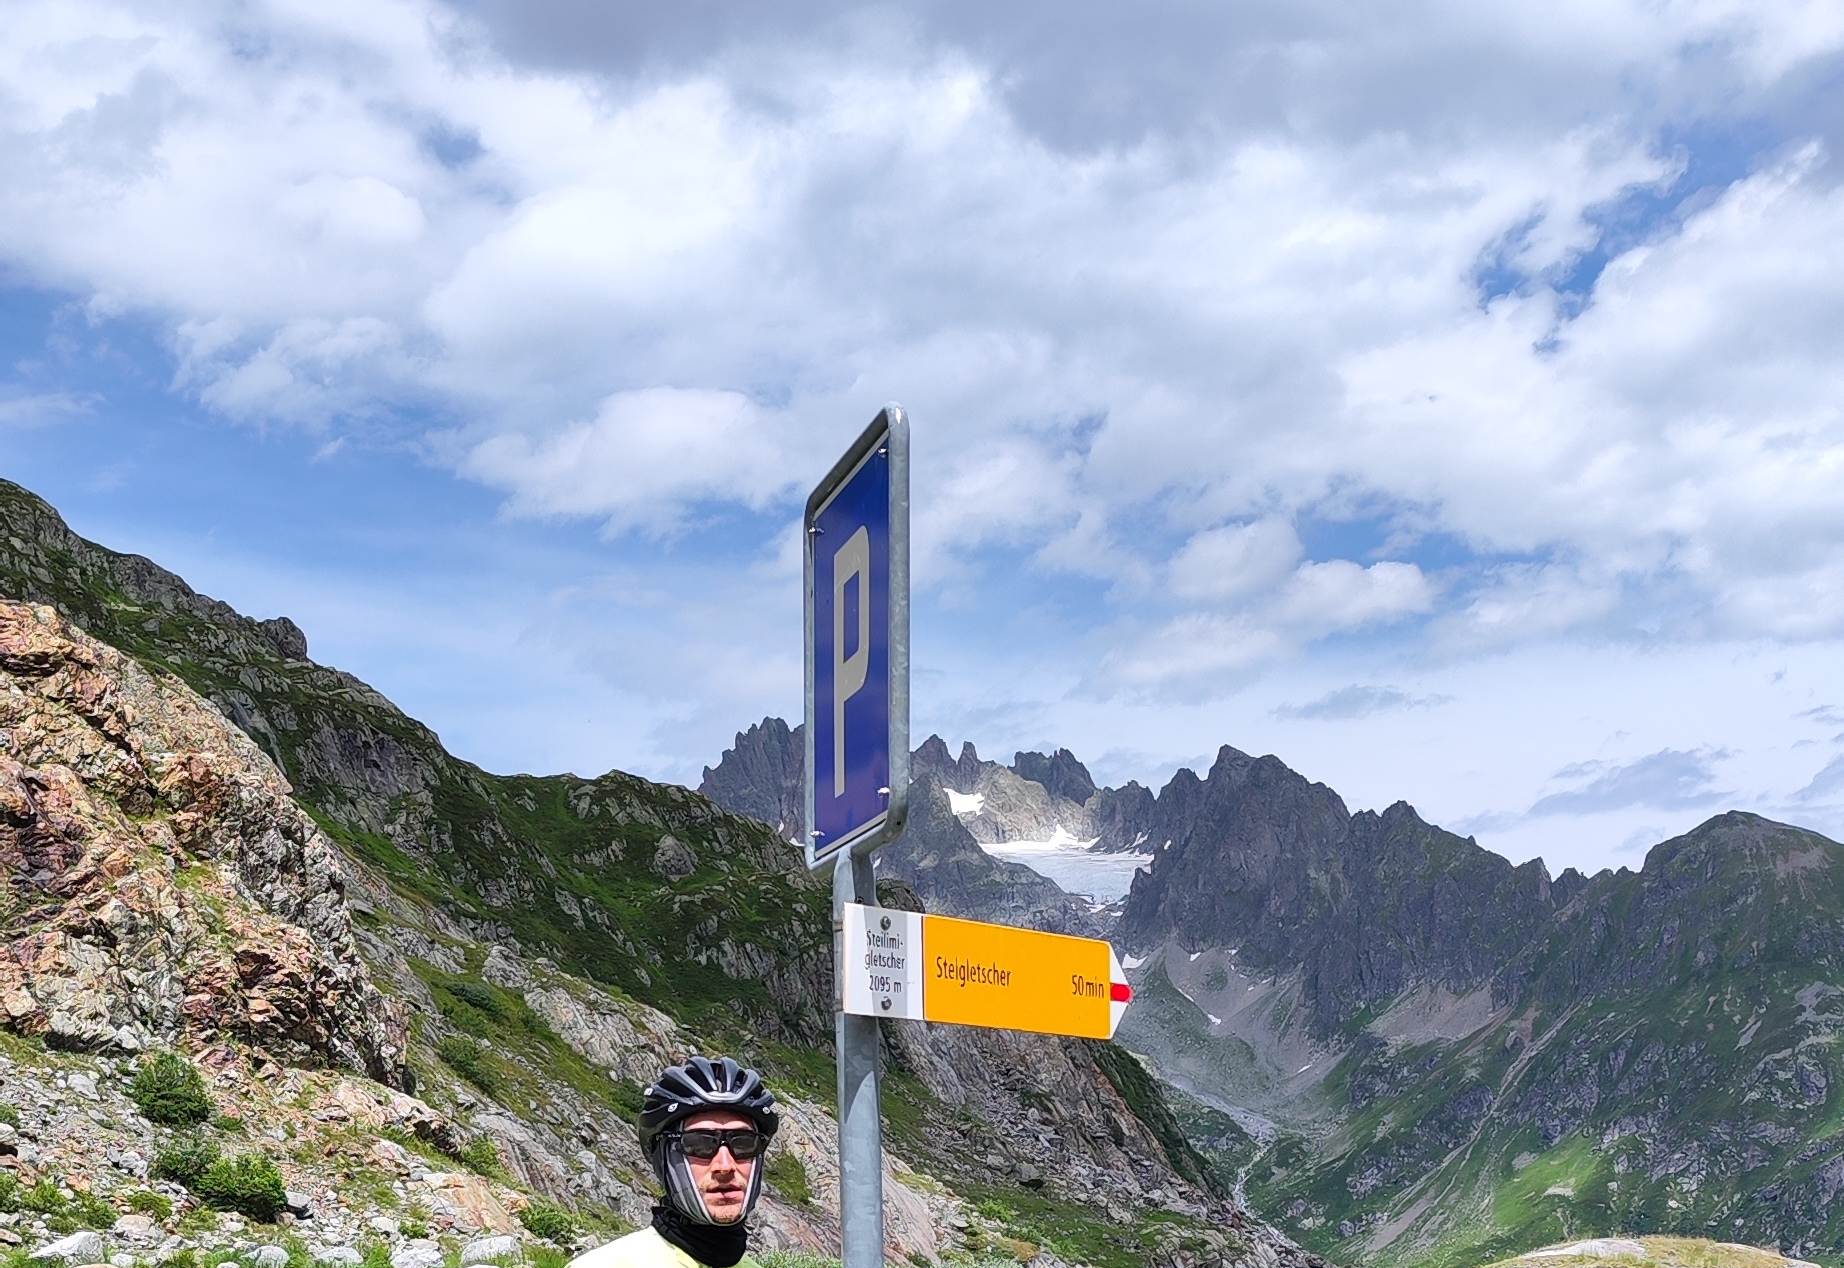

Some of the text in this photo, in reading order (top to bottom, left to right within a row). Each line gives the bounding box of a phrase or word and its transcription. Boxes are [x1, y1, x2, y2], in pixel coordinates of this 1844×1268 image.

[834, 524, 870, 799] P
[866, 928, 904, 950] Steilimi-
[864, 949, 906, 971] gletscher
[936, 955, 1012, 988] Steigletscher
[869, 974, 902, 993] 2095 m
